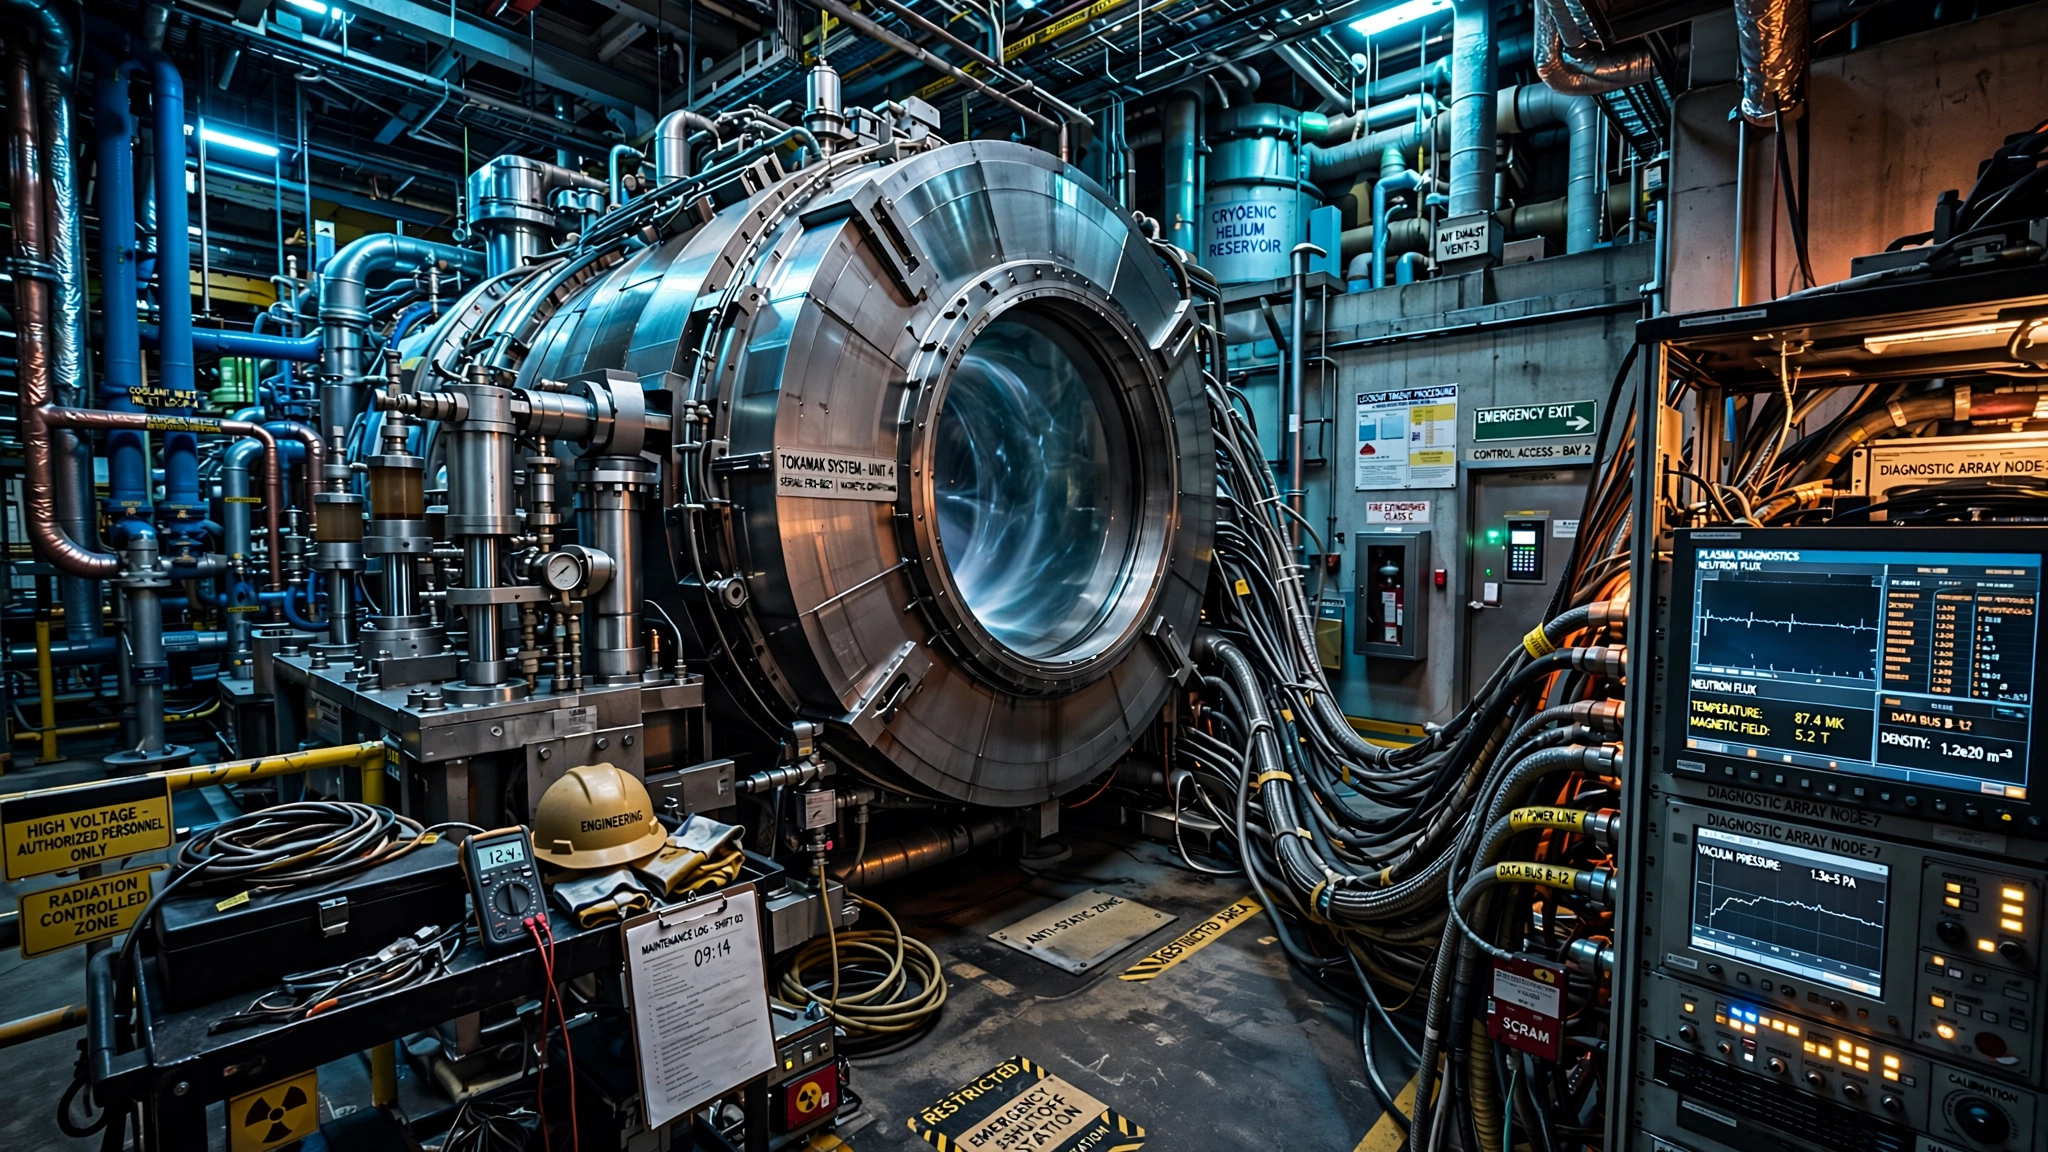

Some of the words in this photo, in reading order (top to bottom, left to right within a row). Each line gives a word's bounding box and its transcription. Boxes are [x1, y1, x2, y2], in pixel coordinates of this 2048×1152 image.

[1216, 222, 1265, 239] HELIUM
[1209, 239, 1281, 258] RESERVOIR
[1445, 241, 1480, 255] VENT-3
[1477, 407, 1545, 423] EMERGENCY
[1548, 404, 1575, 418] EXIT
[1474, 449, 1514, 459] CONTROL
[1517, 446, 1553, 458] ACCESS
[1563, 445, 1581, 456] BAY
[1584, 444, 1591, 456] 2
[780, 454, 825, 472] TOKAMAK
[828, 458, 861, 476] SYSTEM
[869, 463, 886, 477] UNIT
[888, 466, 894, 478] 4
[1880, 463, 1954, 476] DIAGNOSTIC
[1958, 461, 2001, 474] ARRAY
[2005, 459, 2048, 473] NODE-
[1698, 550, 1736, 560] PLASMA
[1738, 551, 1800, 561] DIAGNOSTICS
[1698, 561, 1737, 570] NEUTRON
[1740, 562, 1761, 571] FLUX
[1691, 679, 1732, 692] NEUTRON
[1733, 682, 1757, 695] FLUX
[1690, 716, 1739, 732] MAGNETIC
[1741, 722, 1770, 736] FIELD:
[1795, 712, 1821, 726] 87.4
[1825, 716, 1844, 730] MK
[1891, 712, 1917, 724] DATA
[1920, 715, 1941, 728] BUS
[1795, 728, 1815, 743] 5.2
[1820, 732, 1830, 744] T
[1881, 732, 1931, 749] DENSITY:
[1940, 742, 1984, 760] 1.2e20
[1708, 785, 1781, 810] DIAGNOSTIC
[1784, 799, 1827, 818] ARRAY
[1830, 808, 1881, 828] NODE-7
[27, 819, 66, 839] HIGH
[70, 807, 137, 830] VOLTAGE
[581, 810, 643, 833] ENGINEERING
[17, 829, 99, 856] AUTHORIZED
[102, 818, 165, 840] PERSONNEL
[1707, 813, 1782, 840] DIAGNOSTIC
[1785, 829, 1828, 848] ARRAY
[1831, 838, 1881, 859] NODE-7
[70, 843, 107, 862] ONLY
[1697, 844, 1733, 861] VACUUM
[1500, 865, 1522, 877] DATA
[1525, 867, 1543, 880] BUS
[1842, 873, 1857, 890] PA
[49, 877, 138, 908] RADIATION
[40, 891, 147, 927] CONTROLLED
[74, 913, 119, 936] ZONE
[1026, 910, 1096, 944] ANTI-STATIC
[641, 929, 693, 955] MAINTENANCE
[694, 924, 709, 937] LOG
[715, 917, 733, 930] SHIFT
[694, 939, 731, 967] 09:14
[1503, 1017, 1550, 1044] SCRAM
[922, 1062, 1020, 1126] RESTRICTED
[968, 1087, 1051, 1148] EMERGENCY
